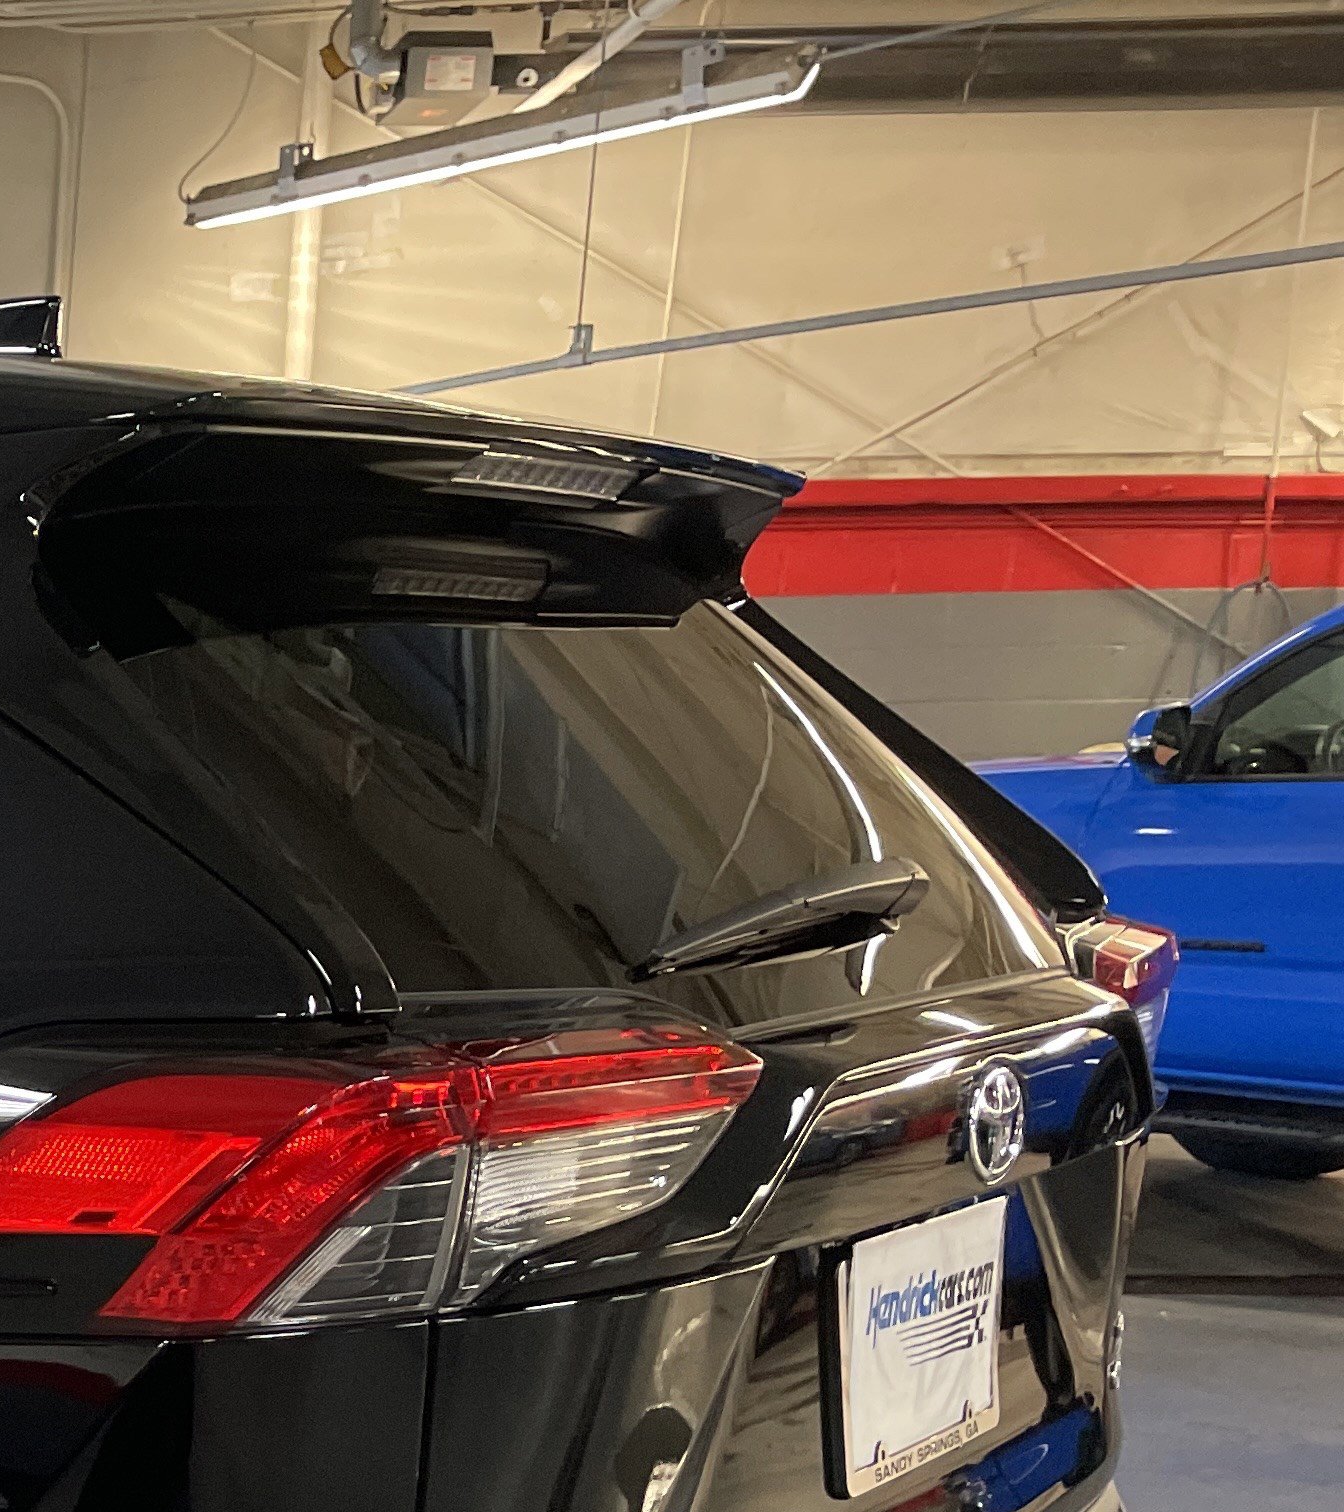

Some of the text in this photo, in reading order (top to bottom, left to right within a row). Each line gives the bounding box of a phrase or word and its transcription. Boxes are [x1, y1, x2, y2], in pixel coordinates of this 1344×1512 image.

[865, 1260, 994, 1349] Hendrickcars.com
[874, 1420, 979, 1483] SANDY SPRINGS GA
